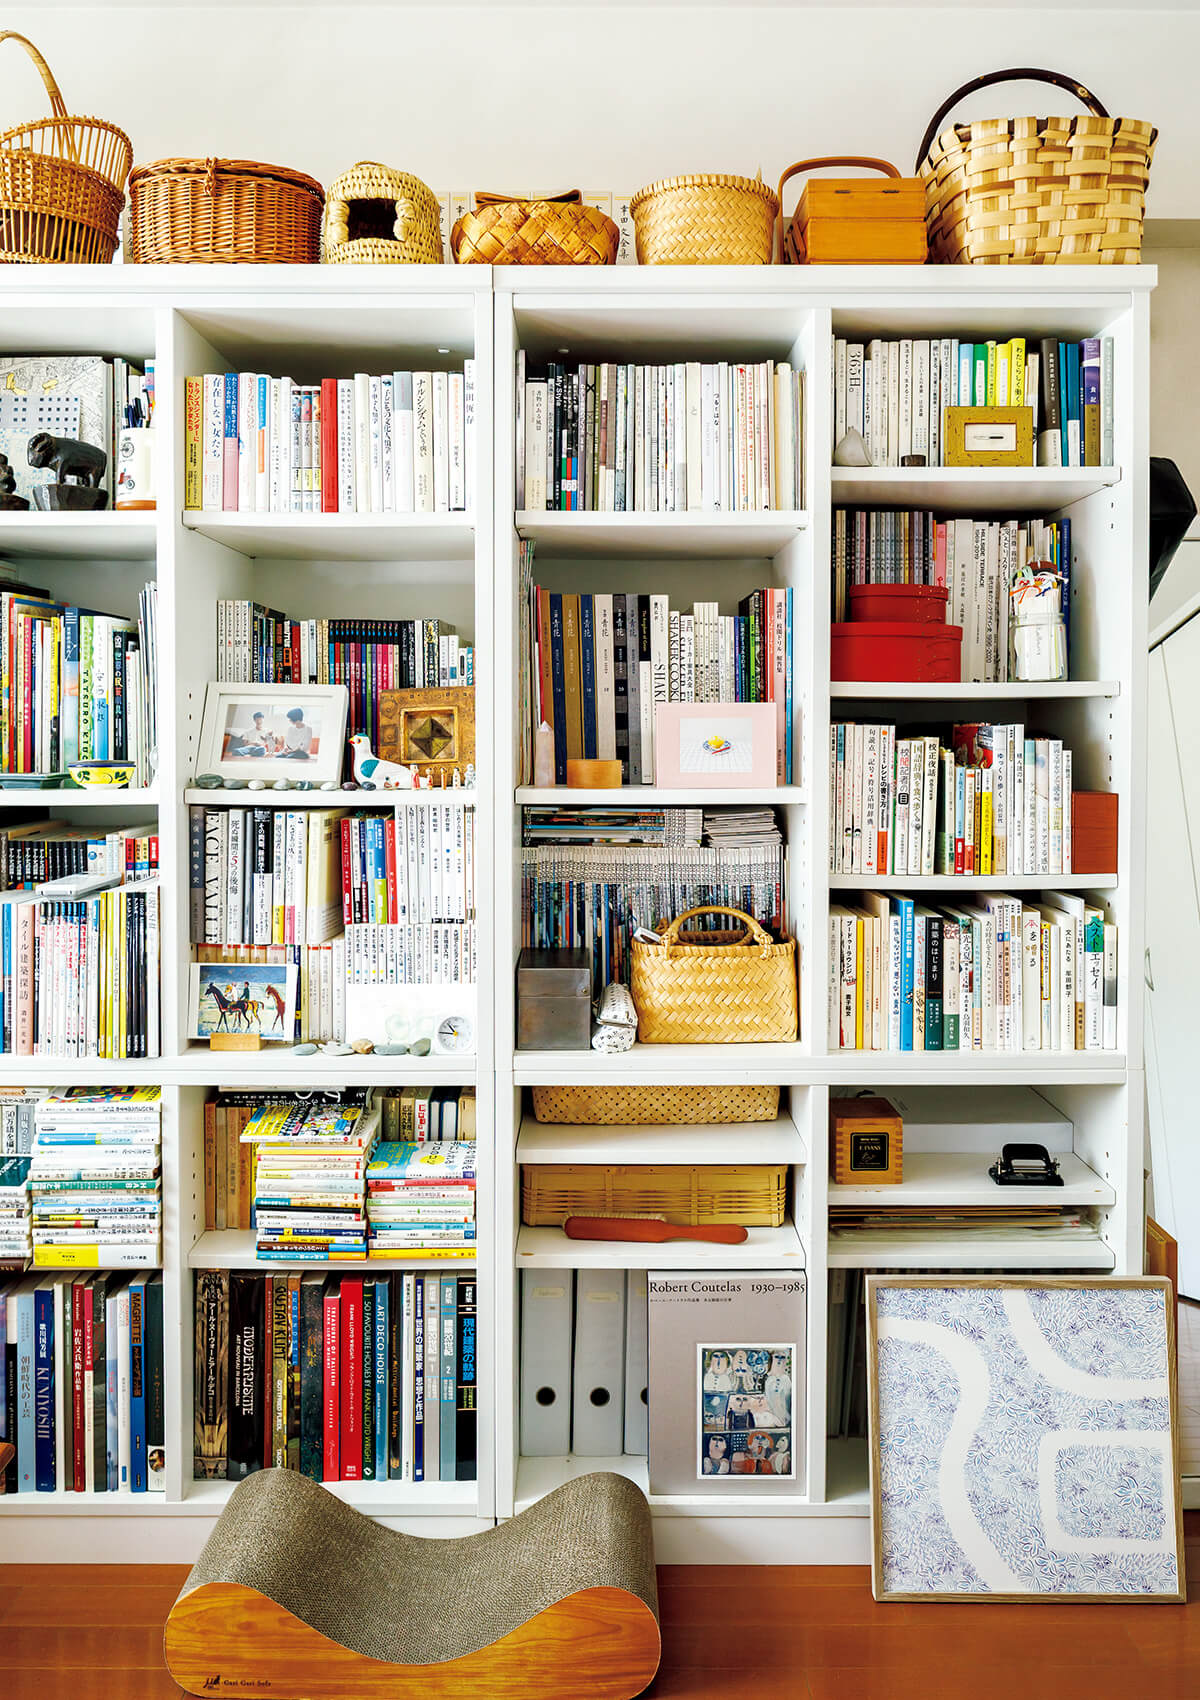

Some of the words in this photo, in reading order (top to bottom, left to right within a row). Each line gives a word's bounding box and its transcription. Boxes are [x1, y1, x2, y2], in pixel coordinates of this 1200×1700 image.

[555, 375, 563, 384] My
[555, 384, 563, 407] Style
[1015, 347, 1023, 407] わたしらしく働く
[193, 381, 201, 443] トランスジェンダーに
[211, 376, 222, 458] 存在しない女たち
[713, 393, 721, 426] つるとはな
[669, 615, 679, 660] SHAKER
[82, 669, 90, 725] TATSURO
[866, 728, 877, 829] 句読点、記号・符号活用辞典。
[898, 748, 910, 805] 校閲記者の目
[927, 743, 937, 777] 校正夜話
[879, 763, 888, 809] レシピの書き方
[912, 742, 923, 822] 国語辞典を食べ歩く
[205, 811, 220, 866] FACE
[205, 876, 220, 944] VALUE
[19, 918, 30, 1002] タイル建築探訪
[931, 921, 939, 981] 建築のはじまり
[962, 934, 971, 961] 光る夏
[274, 1285, 287, 1327] GUSTAV
[649, 1281, 688, 1294] Robert
[691, 1280, 742, 1293] Coutelas
[131, 1292, 142, 1345] MAGRITTE
[363, 1312, 373, 1350] FAVOURITE
[375, 1304, 385, 1321] ART
[274, 1329, 286, 1361] KLIMT
[375, 1324, 385, 1351] DECO
[363, 1350, 373, 1379] HOUSES
[363, 1379, 373, 1388] BY
[375, 1352, 385, 1385] HOUSE
[446, 1365, 452, 1375] 2
[36, 1366, 50, 1440] KUNIYOSHI
[363, 1388, 373, 1412] FRANK
[363, 1412, 373, 1436] LLOYD
[363, 1436, 373, 1464] WRIGHT
